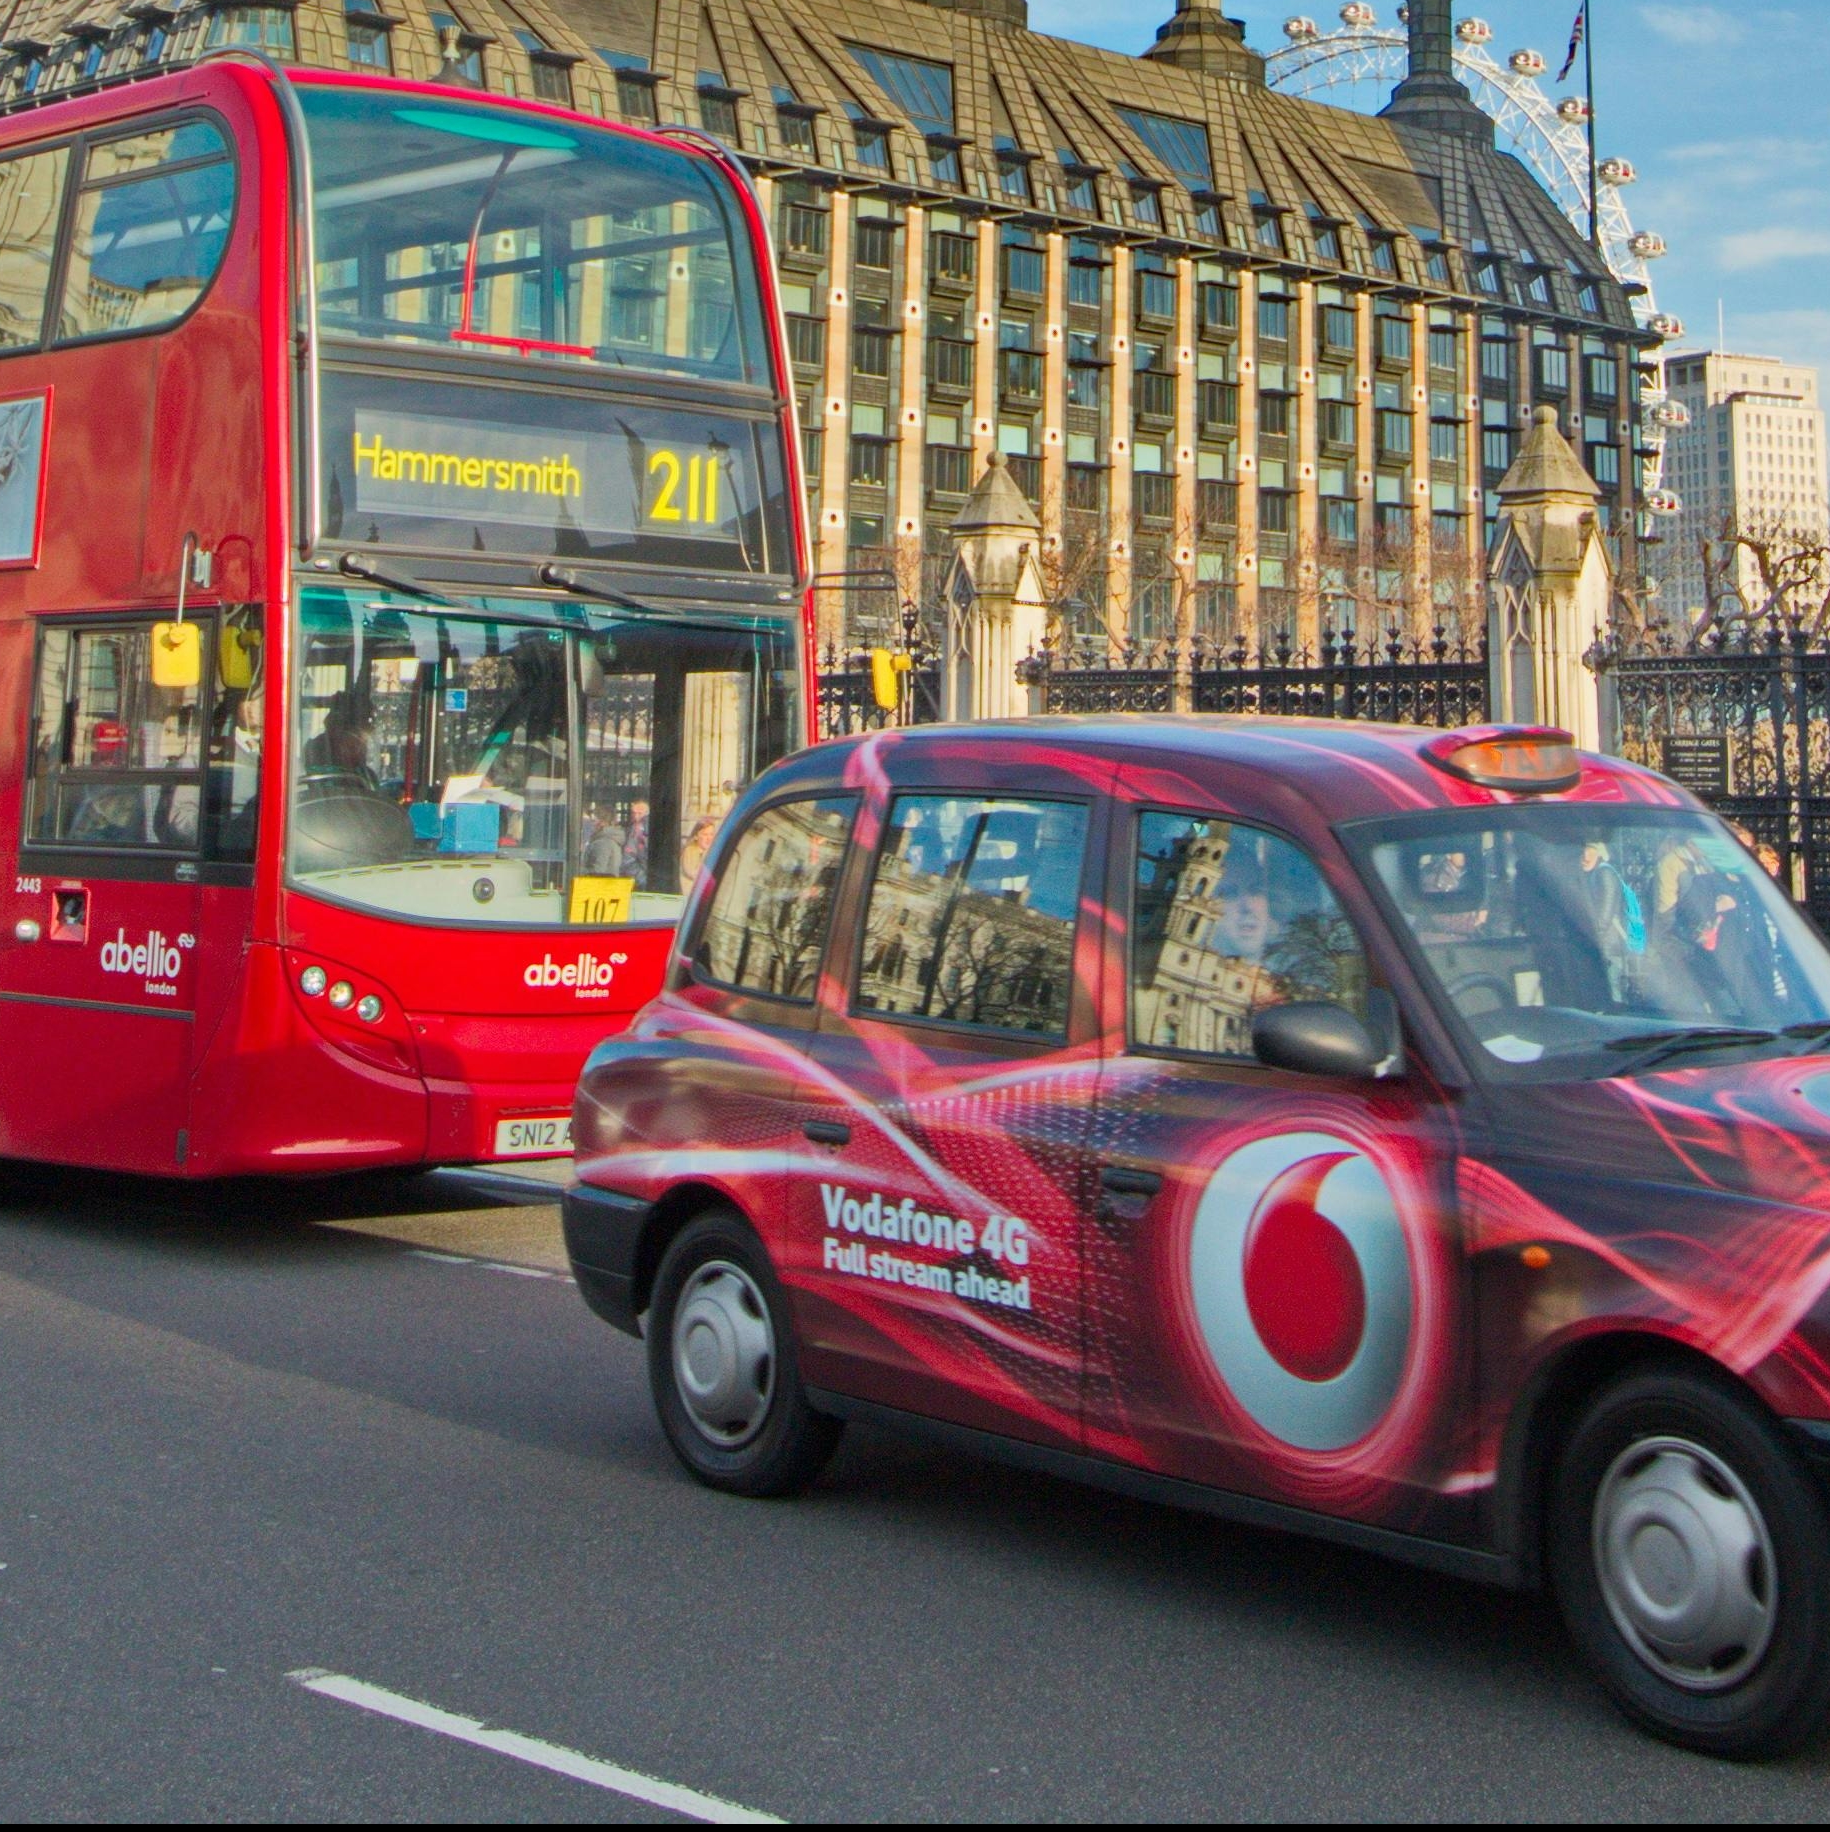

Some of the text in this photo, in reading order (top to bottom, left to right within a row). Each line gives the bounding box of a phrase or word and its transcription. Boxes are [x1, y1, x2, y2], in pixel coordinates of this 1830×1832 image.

[354, 432, 720, 523] Hammersmith 211
[15, 877, 42, 894] 2443
[100, 928, 181, 978] abellio
[524, 953, 614, 987] abellio
[145, 980, 177, 996] london
[575, 988, 610, 999] london
[509, 1123, 556, 1147] SN12
[820, 1183, 1029, 1266] Vodafone 4G
[823, 1238, 1032, 1310] Full stream ahead
